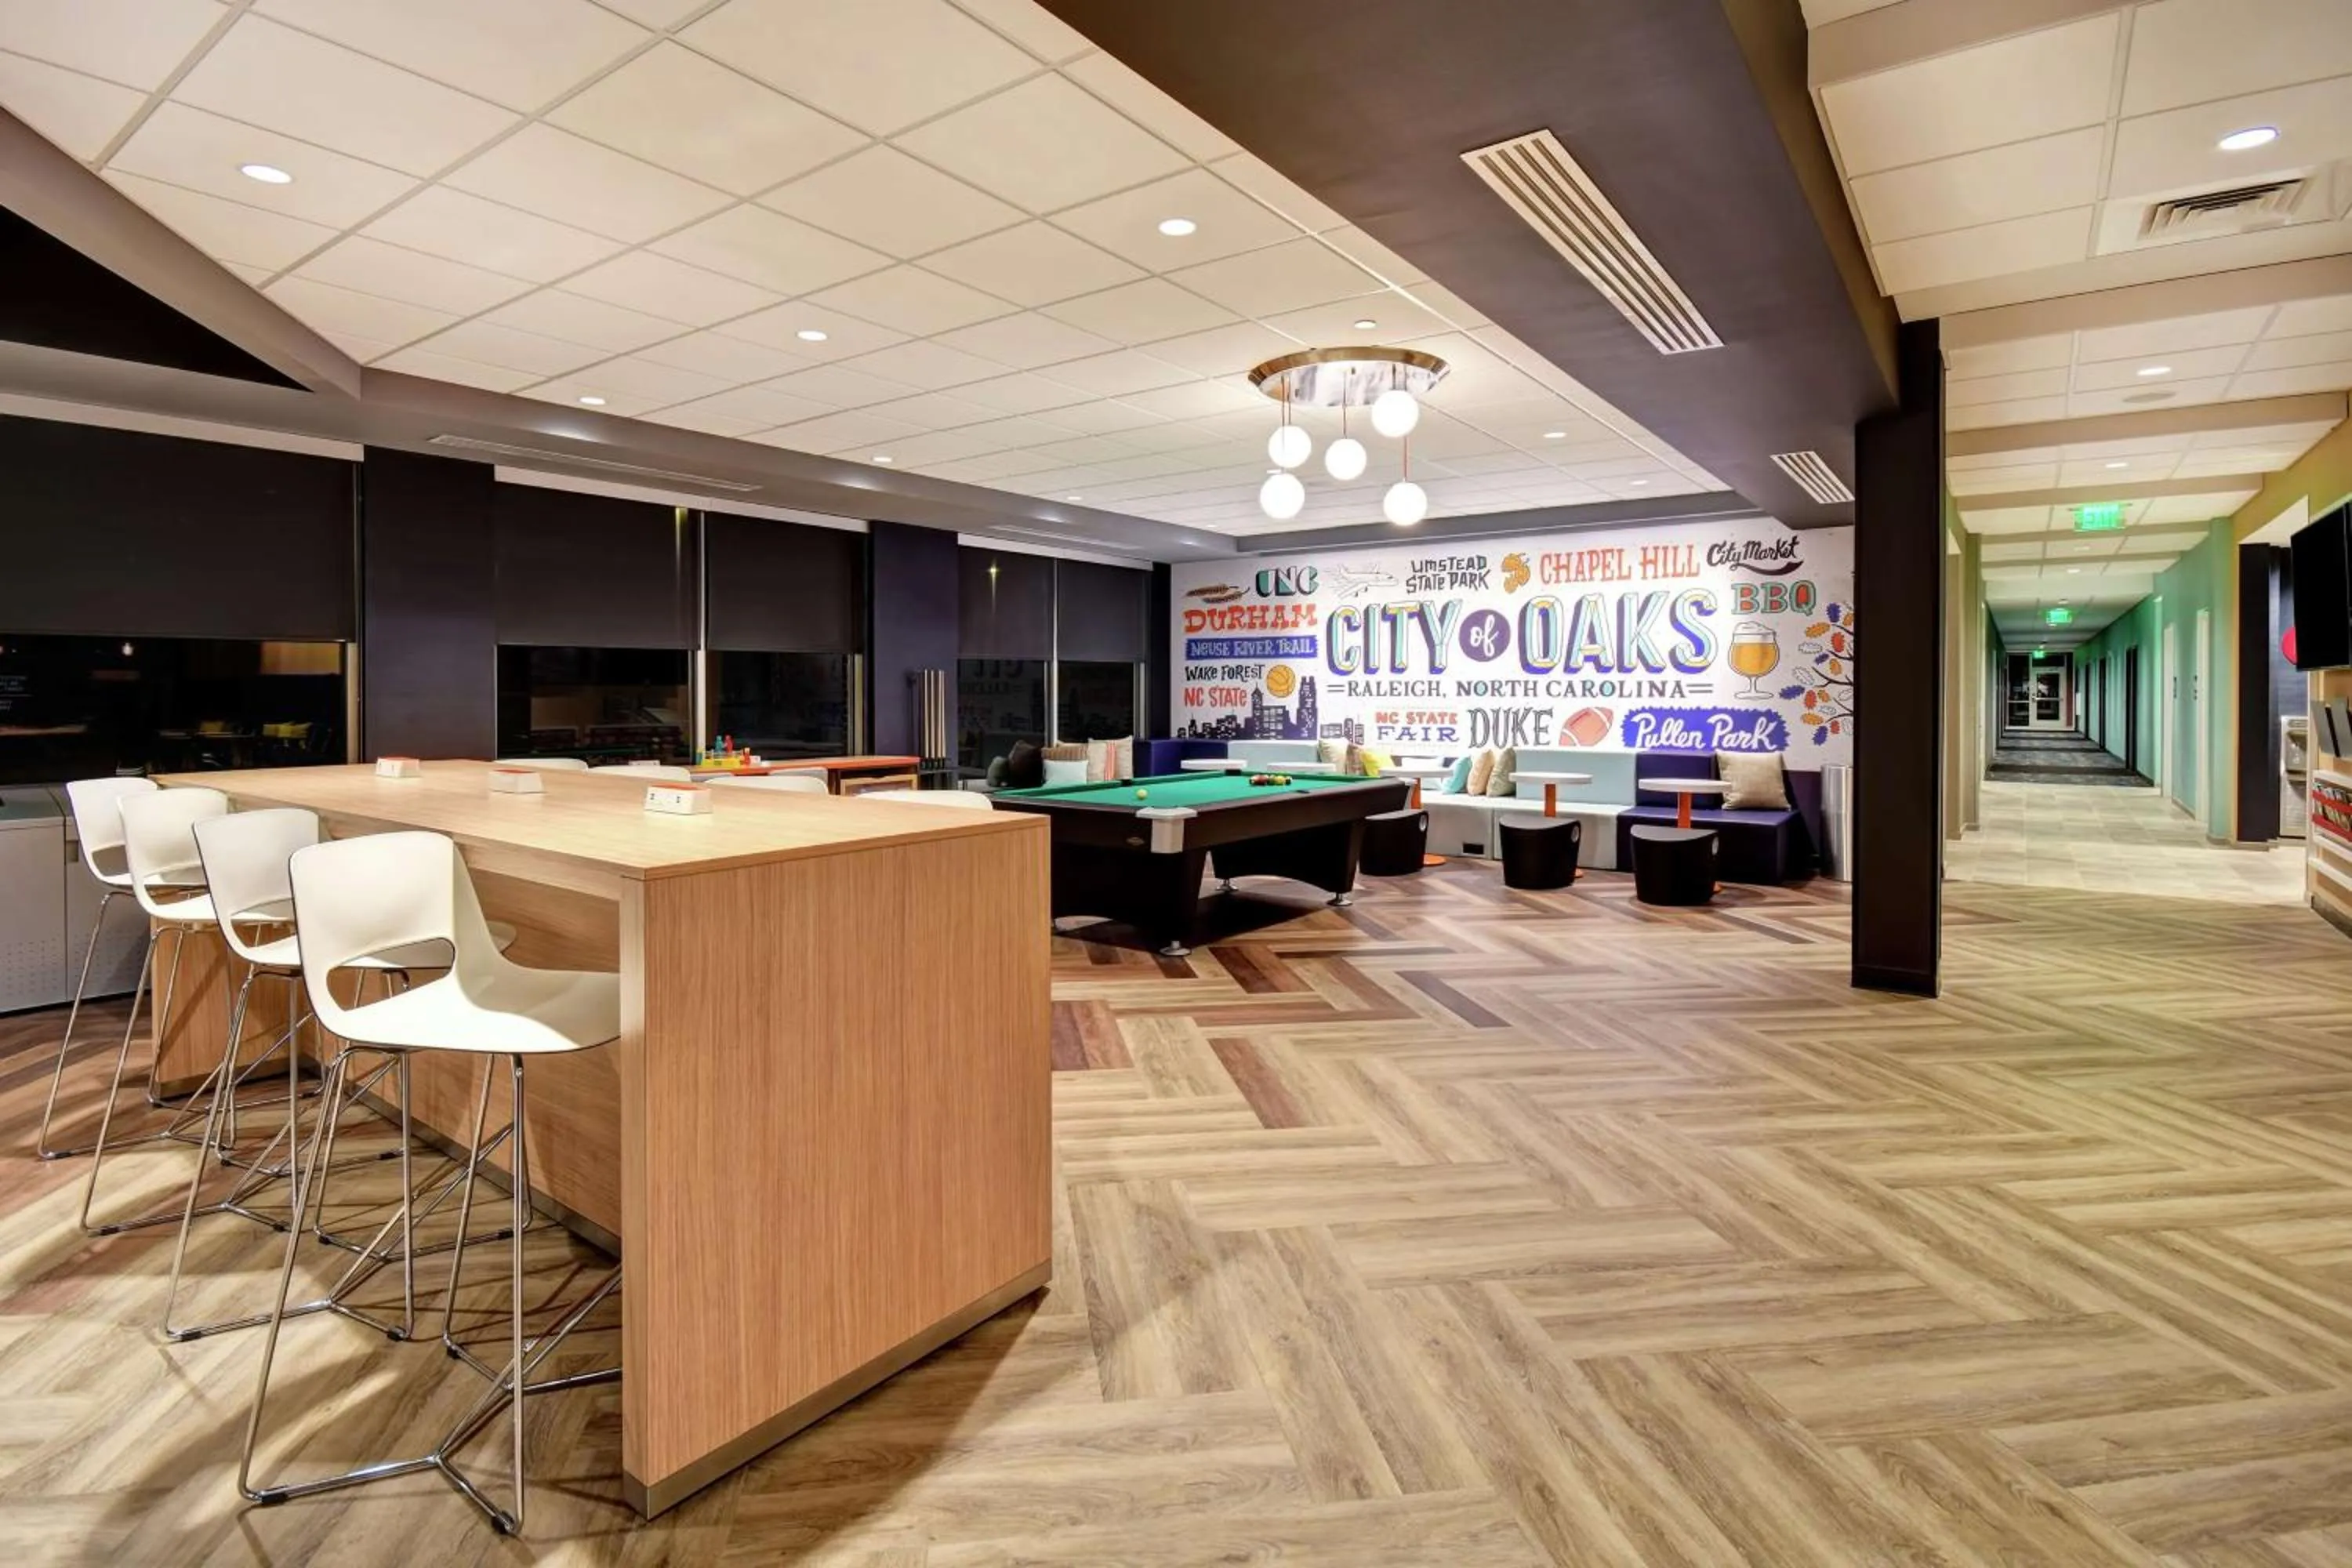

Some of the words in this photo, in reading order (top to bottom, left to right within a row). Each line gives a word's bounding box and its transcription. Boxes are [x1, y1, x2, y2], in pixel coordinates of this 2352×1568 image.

[1540, 548, 1632, 585] CHAPEL
[1639, 544, 1700, 580] HILL
[1707, 540, 1742, 571] City
[1743, 535, 1800, 561] Market
[1256, 565, 1319, 597] UNC
[1447, 569, 1491, 591] PARK
[1730, 579, 1817, 616] BBQ
[1183, 603, 1318, 633] DURHAM
[1326, 598, 1464, 676] CITY
[1470, 614, 1499, 657] of
[1518, 588, 1719, 674] OAKS
[1233, 640, 1276, 656] RIVER
[1221, 664, 1266, 683] FOREST
[1184, 686, 1204, 706] NC
[1347, 680, 1447, 699] RALEIGH,
[1456, 680, 1537, 698] NORTH
[1545, 680, 1686, 699] CAROLINA
[1375, 712, 1399, 724] NC
[1406, 712, 1459, 725] STATE
[1468, 706, 1553, 749] DUKE
[1631, 713, 1706, 749] Pullen
[1706, 713, 1778, 750] Park
[1377, 726, 1460, 742] FAIR
